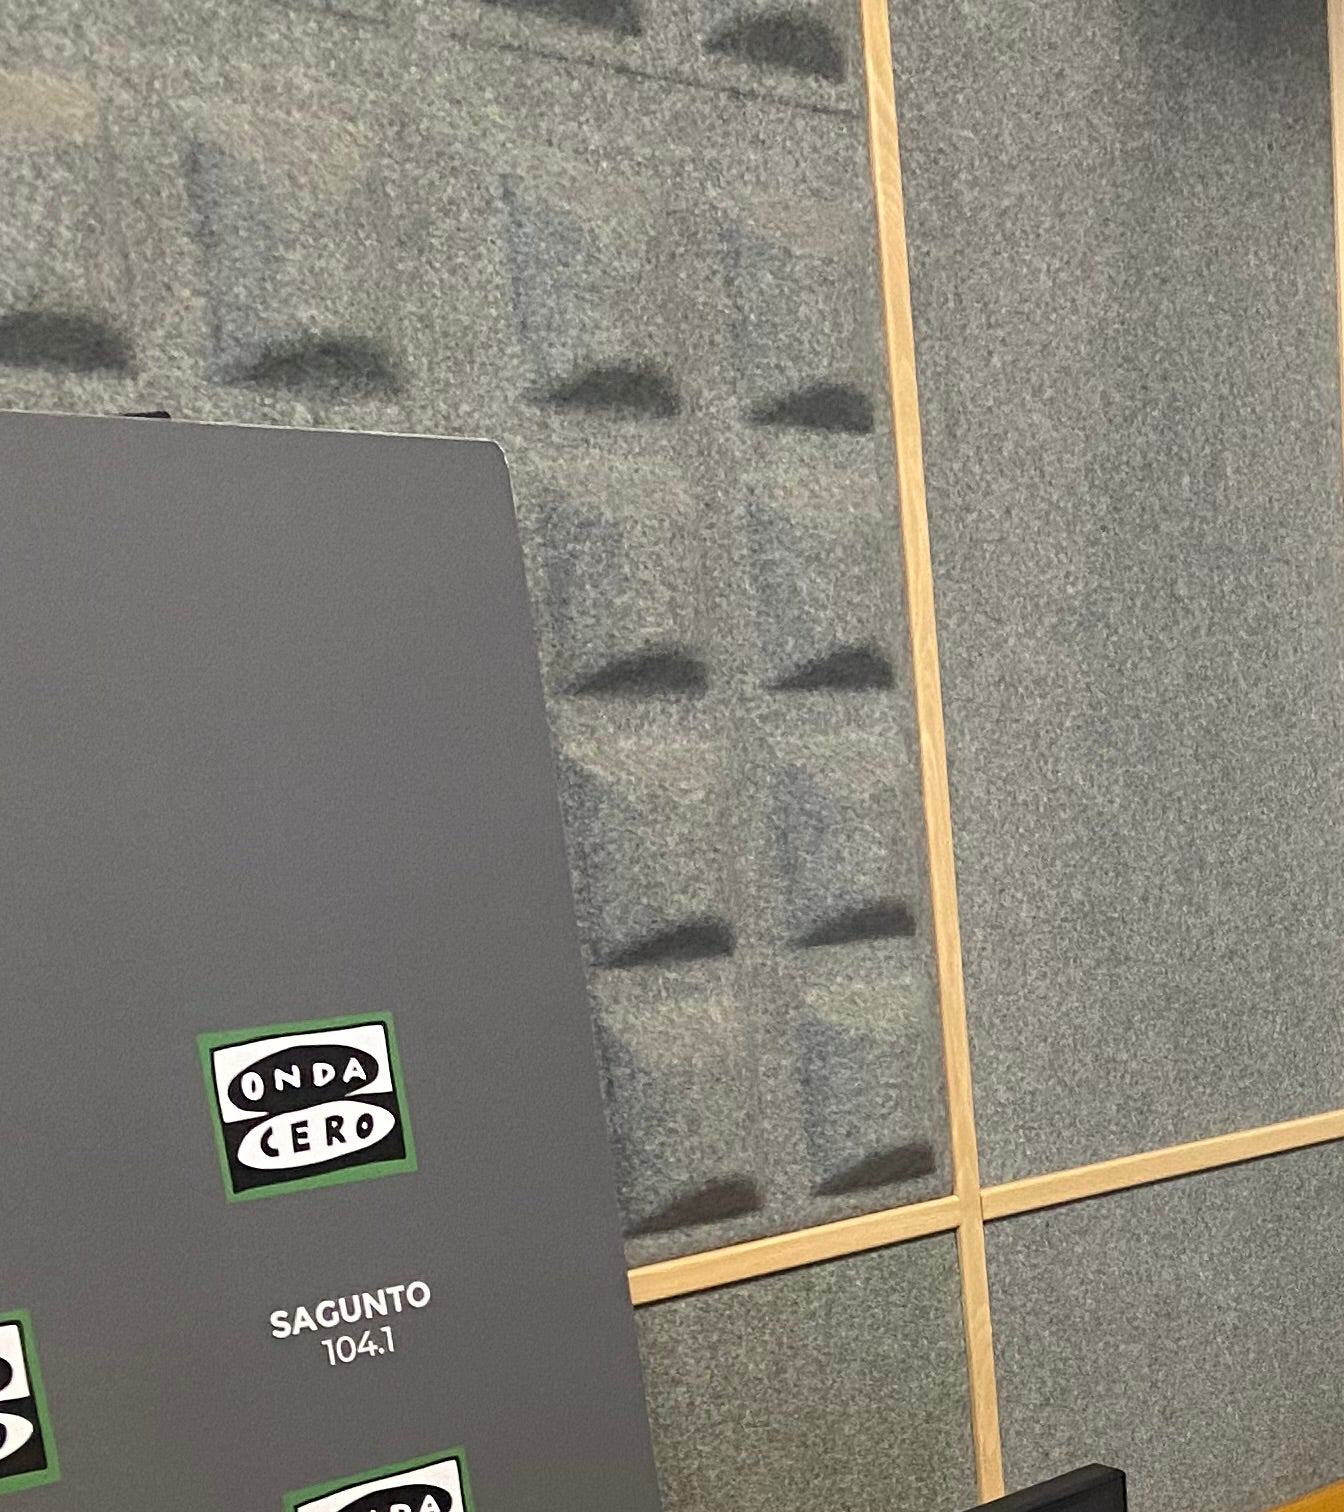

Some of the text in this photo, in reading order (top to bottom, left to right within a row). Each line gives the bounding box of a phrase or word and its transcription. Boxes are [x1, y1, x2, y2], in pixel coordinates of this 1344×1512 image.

[240, 1056, 367, 1102] ONDA
[260, 1113, 374, 1158] CERO
[269, 1280, 432, 1339] SAGUNTO
[320, 1325, 395, 1366] 104.1
